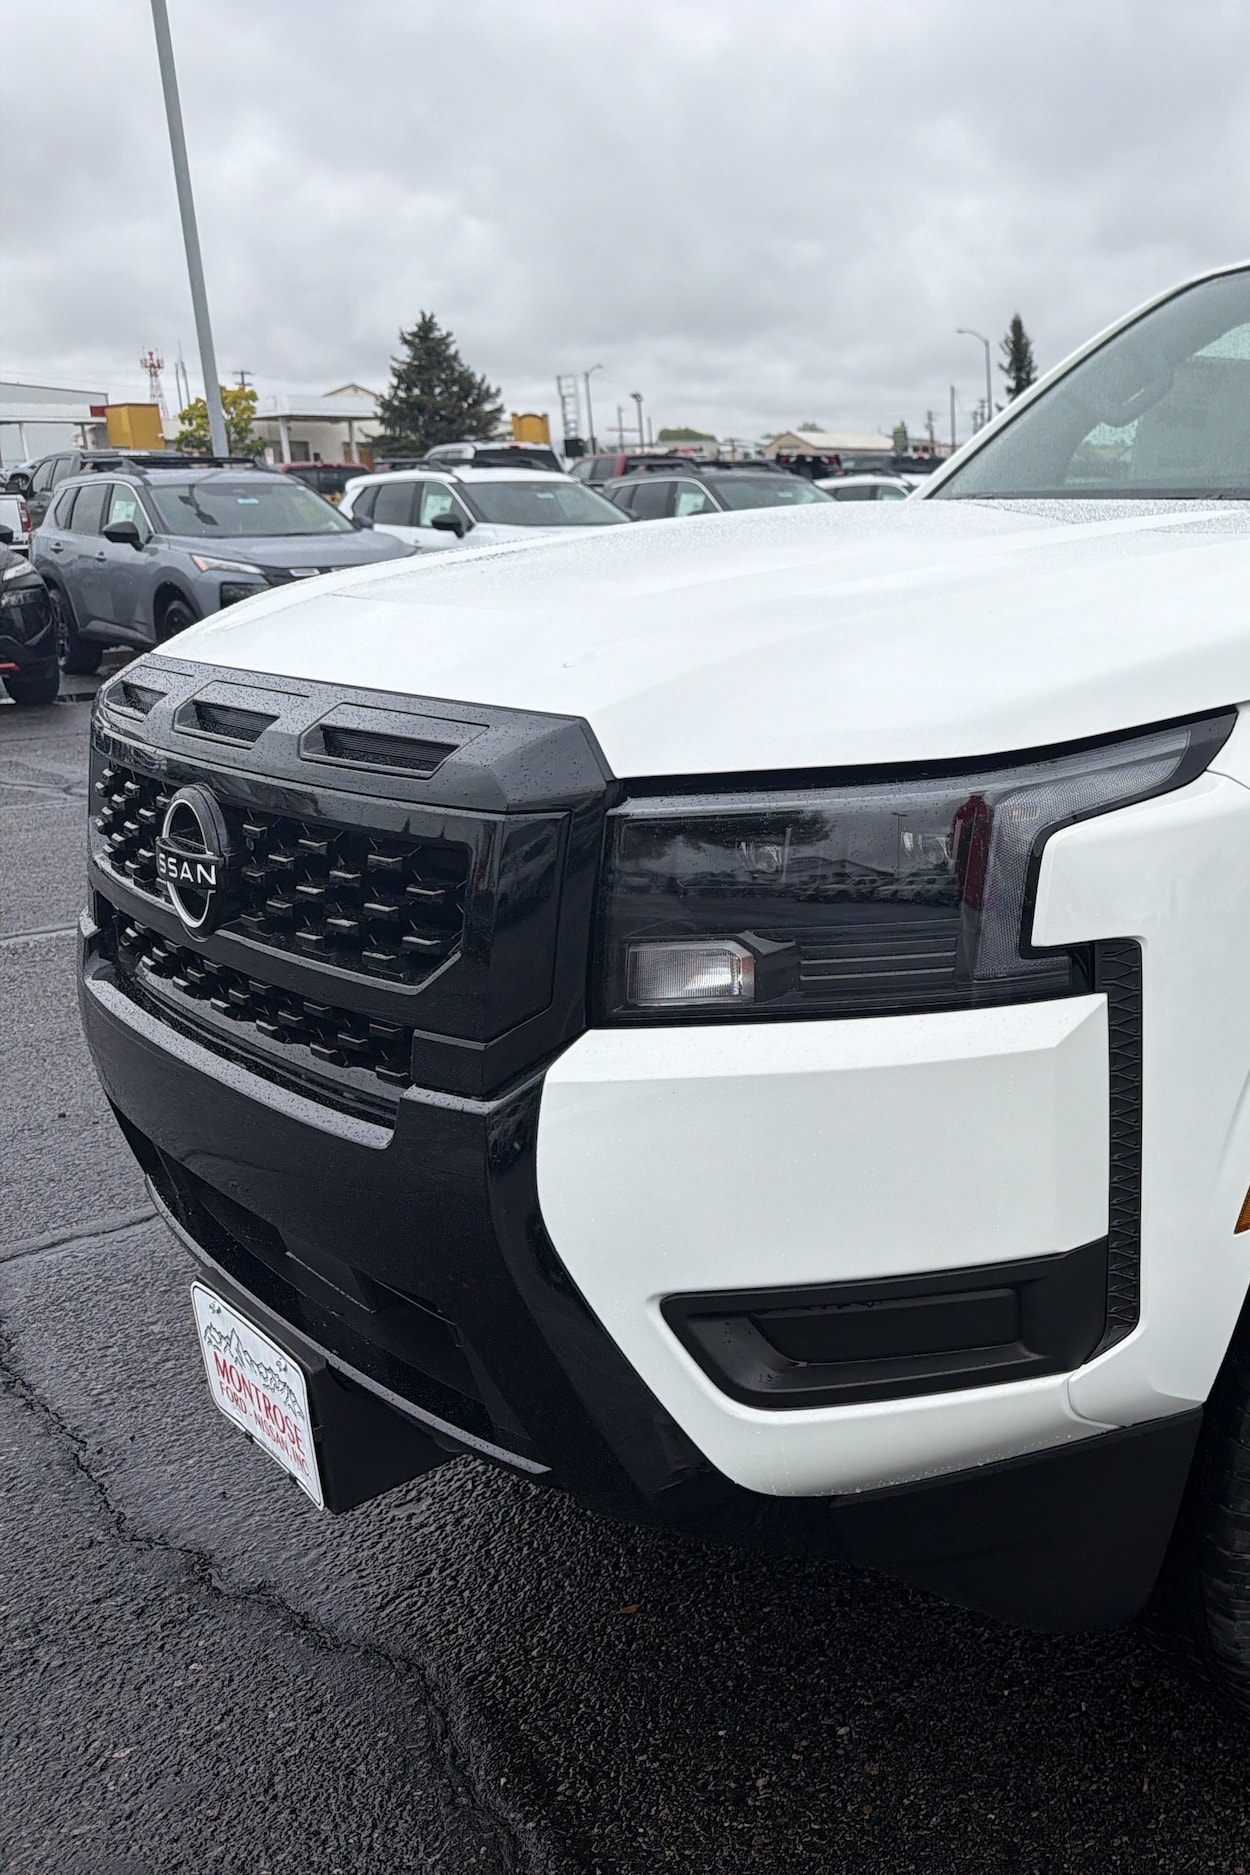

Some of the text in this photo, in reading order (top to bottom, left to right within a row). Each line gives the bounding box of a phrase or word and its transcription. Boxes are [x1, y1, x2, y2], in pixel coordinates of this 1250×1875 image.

[158, 851, 217, 886] SSAN
[213, 1350, 306, 1458] MONTROSE
[219, 1379, 248, 1415] FORD
